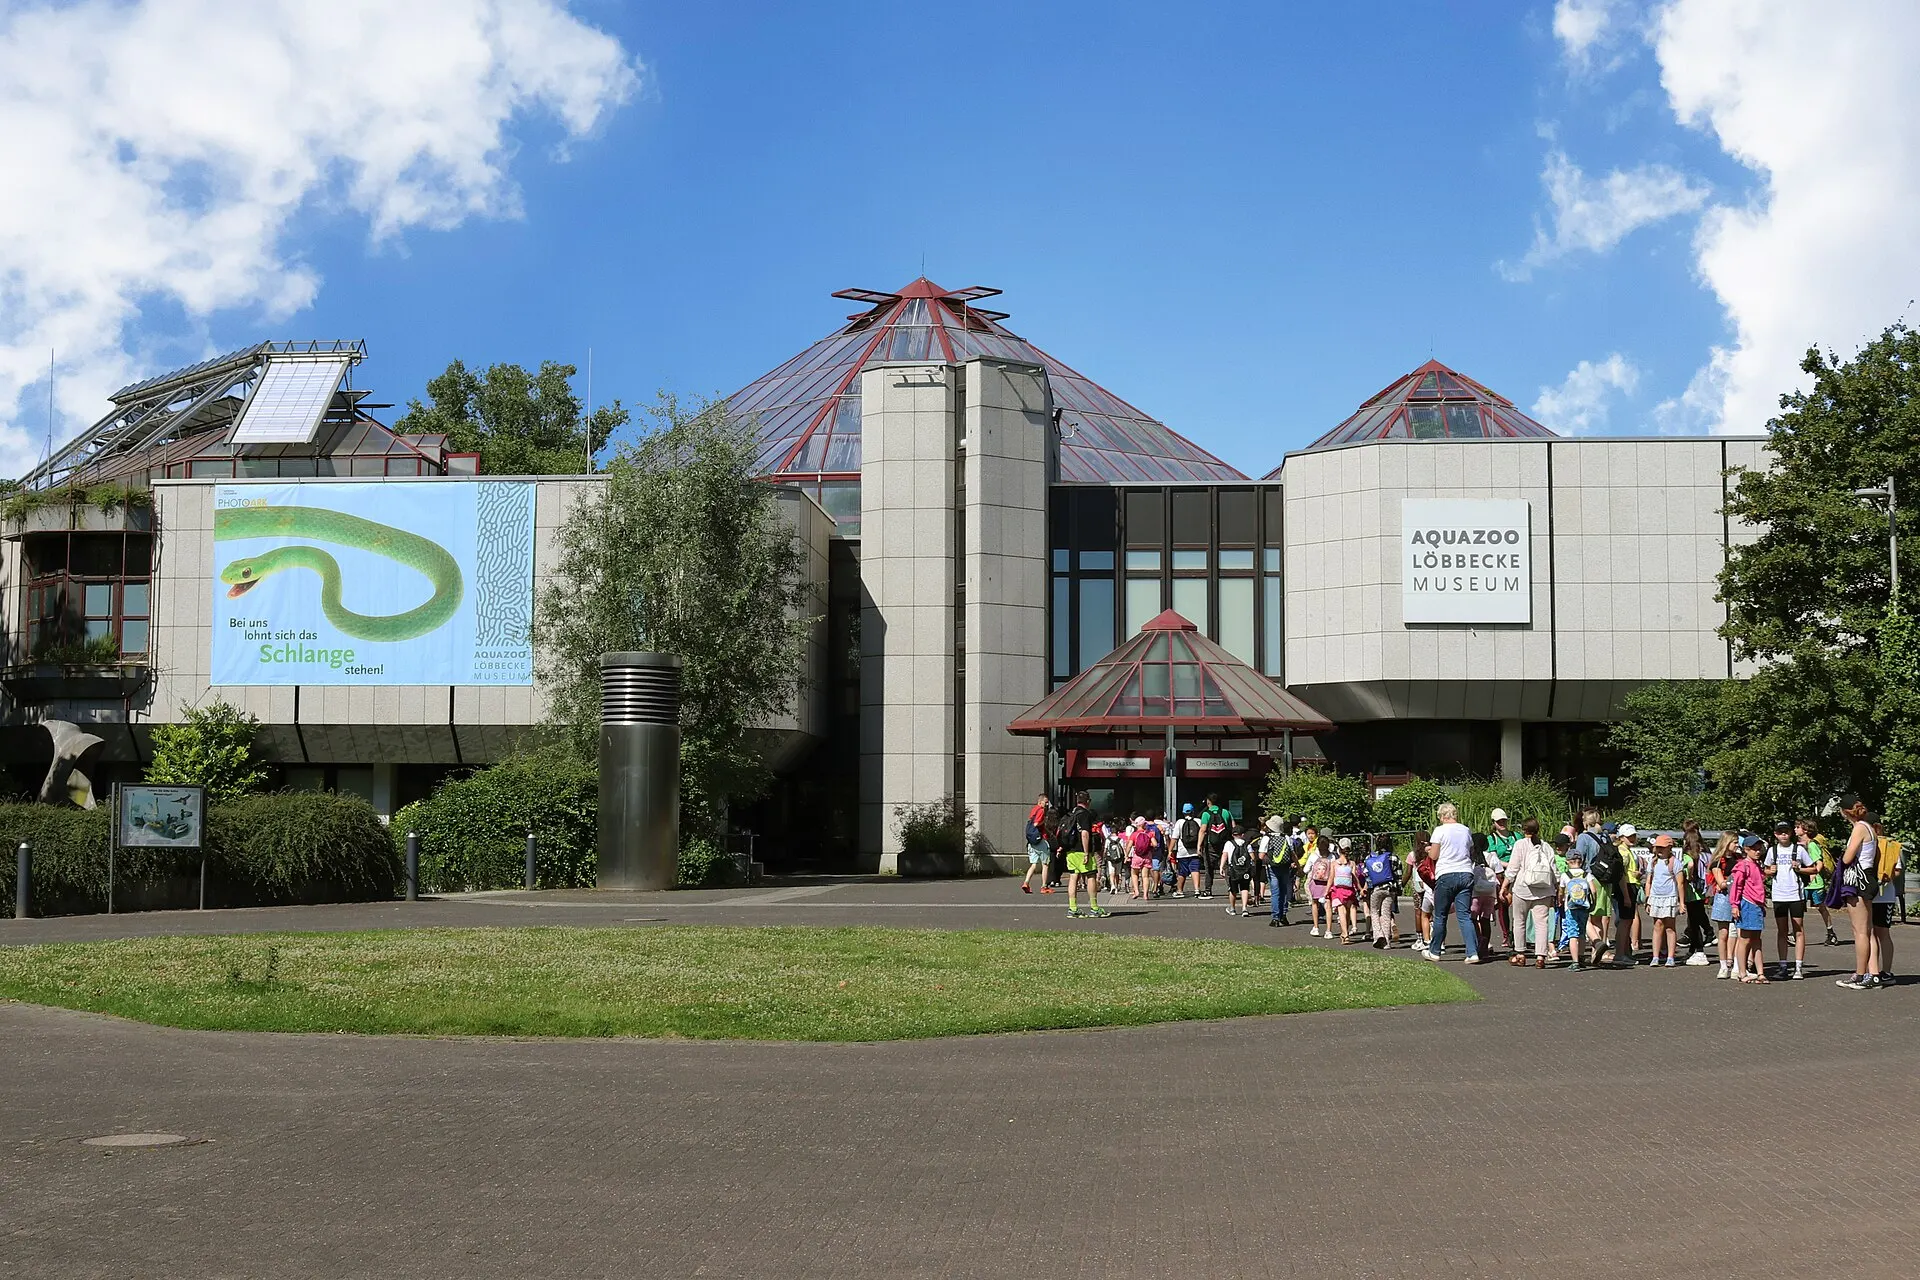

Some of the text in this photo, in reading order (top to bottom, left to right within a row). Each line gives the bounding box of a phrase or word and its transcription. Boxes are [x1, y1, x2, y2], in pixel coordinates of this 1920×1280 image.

[1411, 530, 1520, 549] AQUAZOO
[1413, 551, 1520, 568] LÖBBECKE
[1413, 577, 1519, 591] MUSEUM
[229, 618, 268, 628] Bei uns
[244, 630, 318, 640] lohnt sich das
[259, 643, 355, 669] Schlange
[344, 664, 384, 675] stehen!
[474, 661, 525, 670] LÖBBECKE
[1102, 760, 1135, 768] Tageskasse
